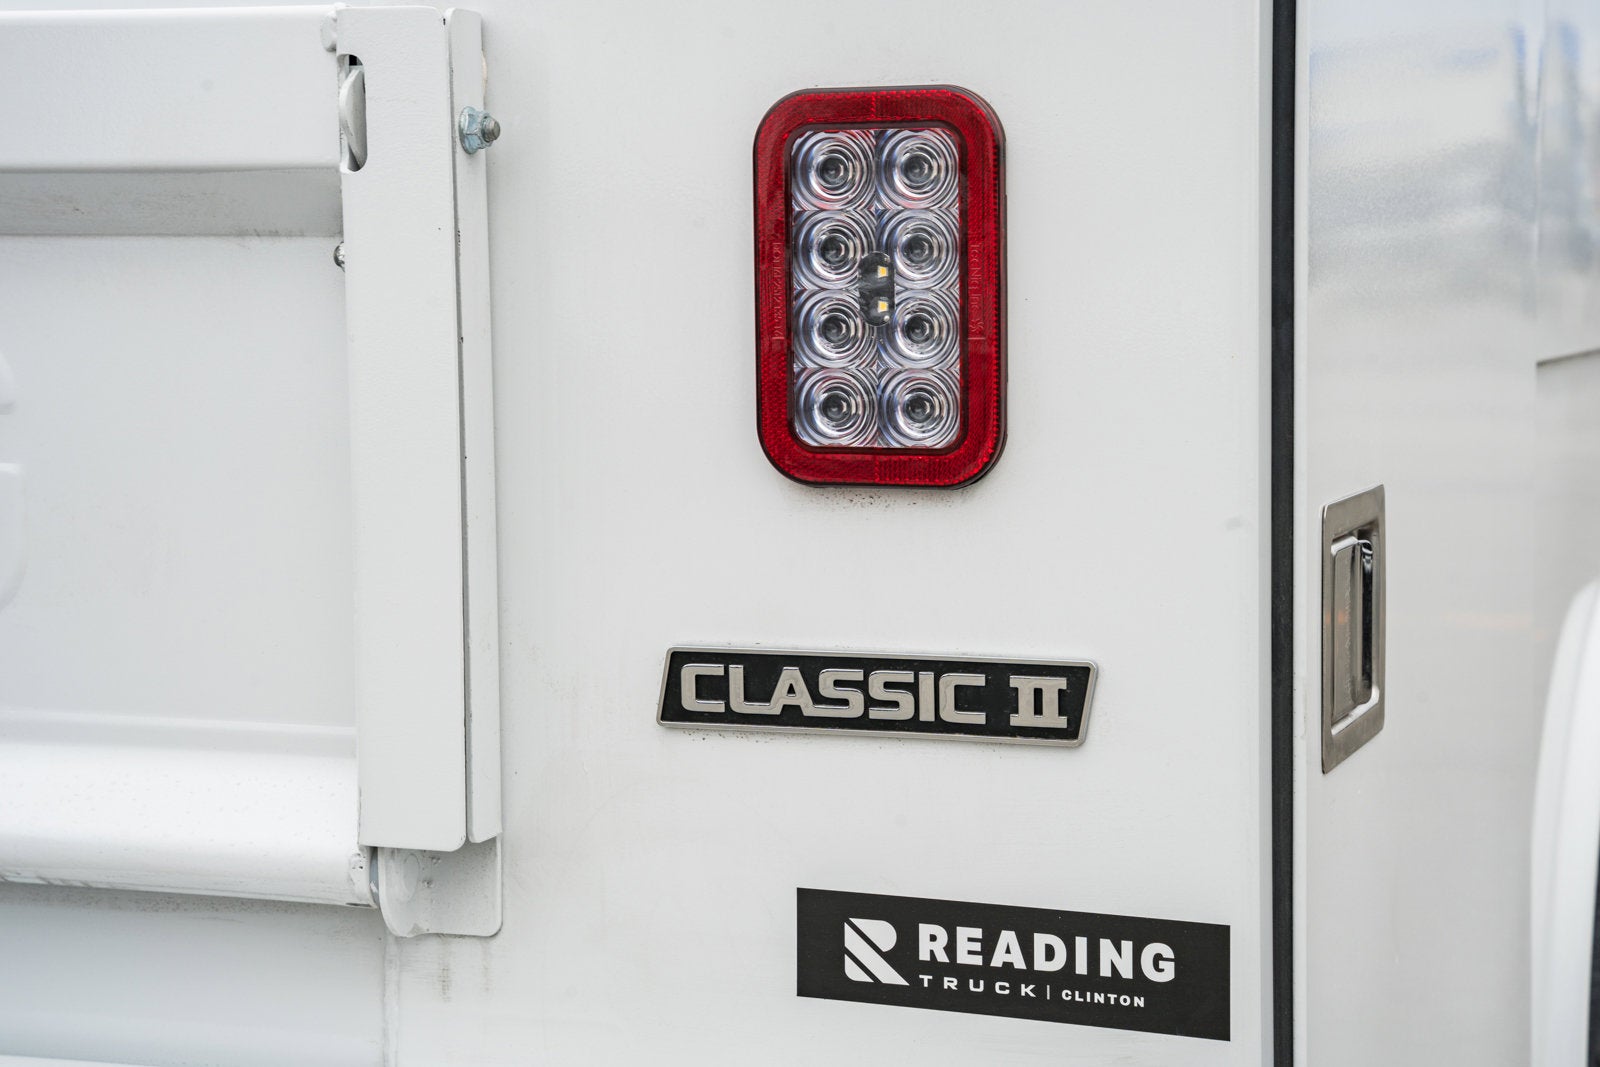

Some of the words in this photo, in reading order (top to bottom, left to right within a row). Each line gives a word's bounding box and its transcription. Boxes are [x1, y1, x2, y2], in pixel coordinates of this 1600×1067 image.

[681, 662, 987, 725] CLASSIC
[1009, 674, 1068, 729] II
[919, 923, 1175, 983] READING
[919, 974, 1036, 998] TRUCK
[1061, 989, 1145, 1008] CLINTON
